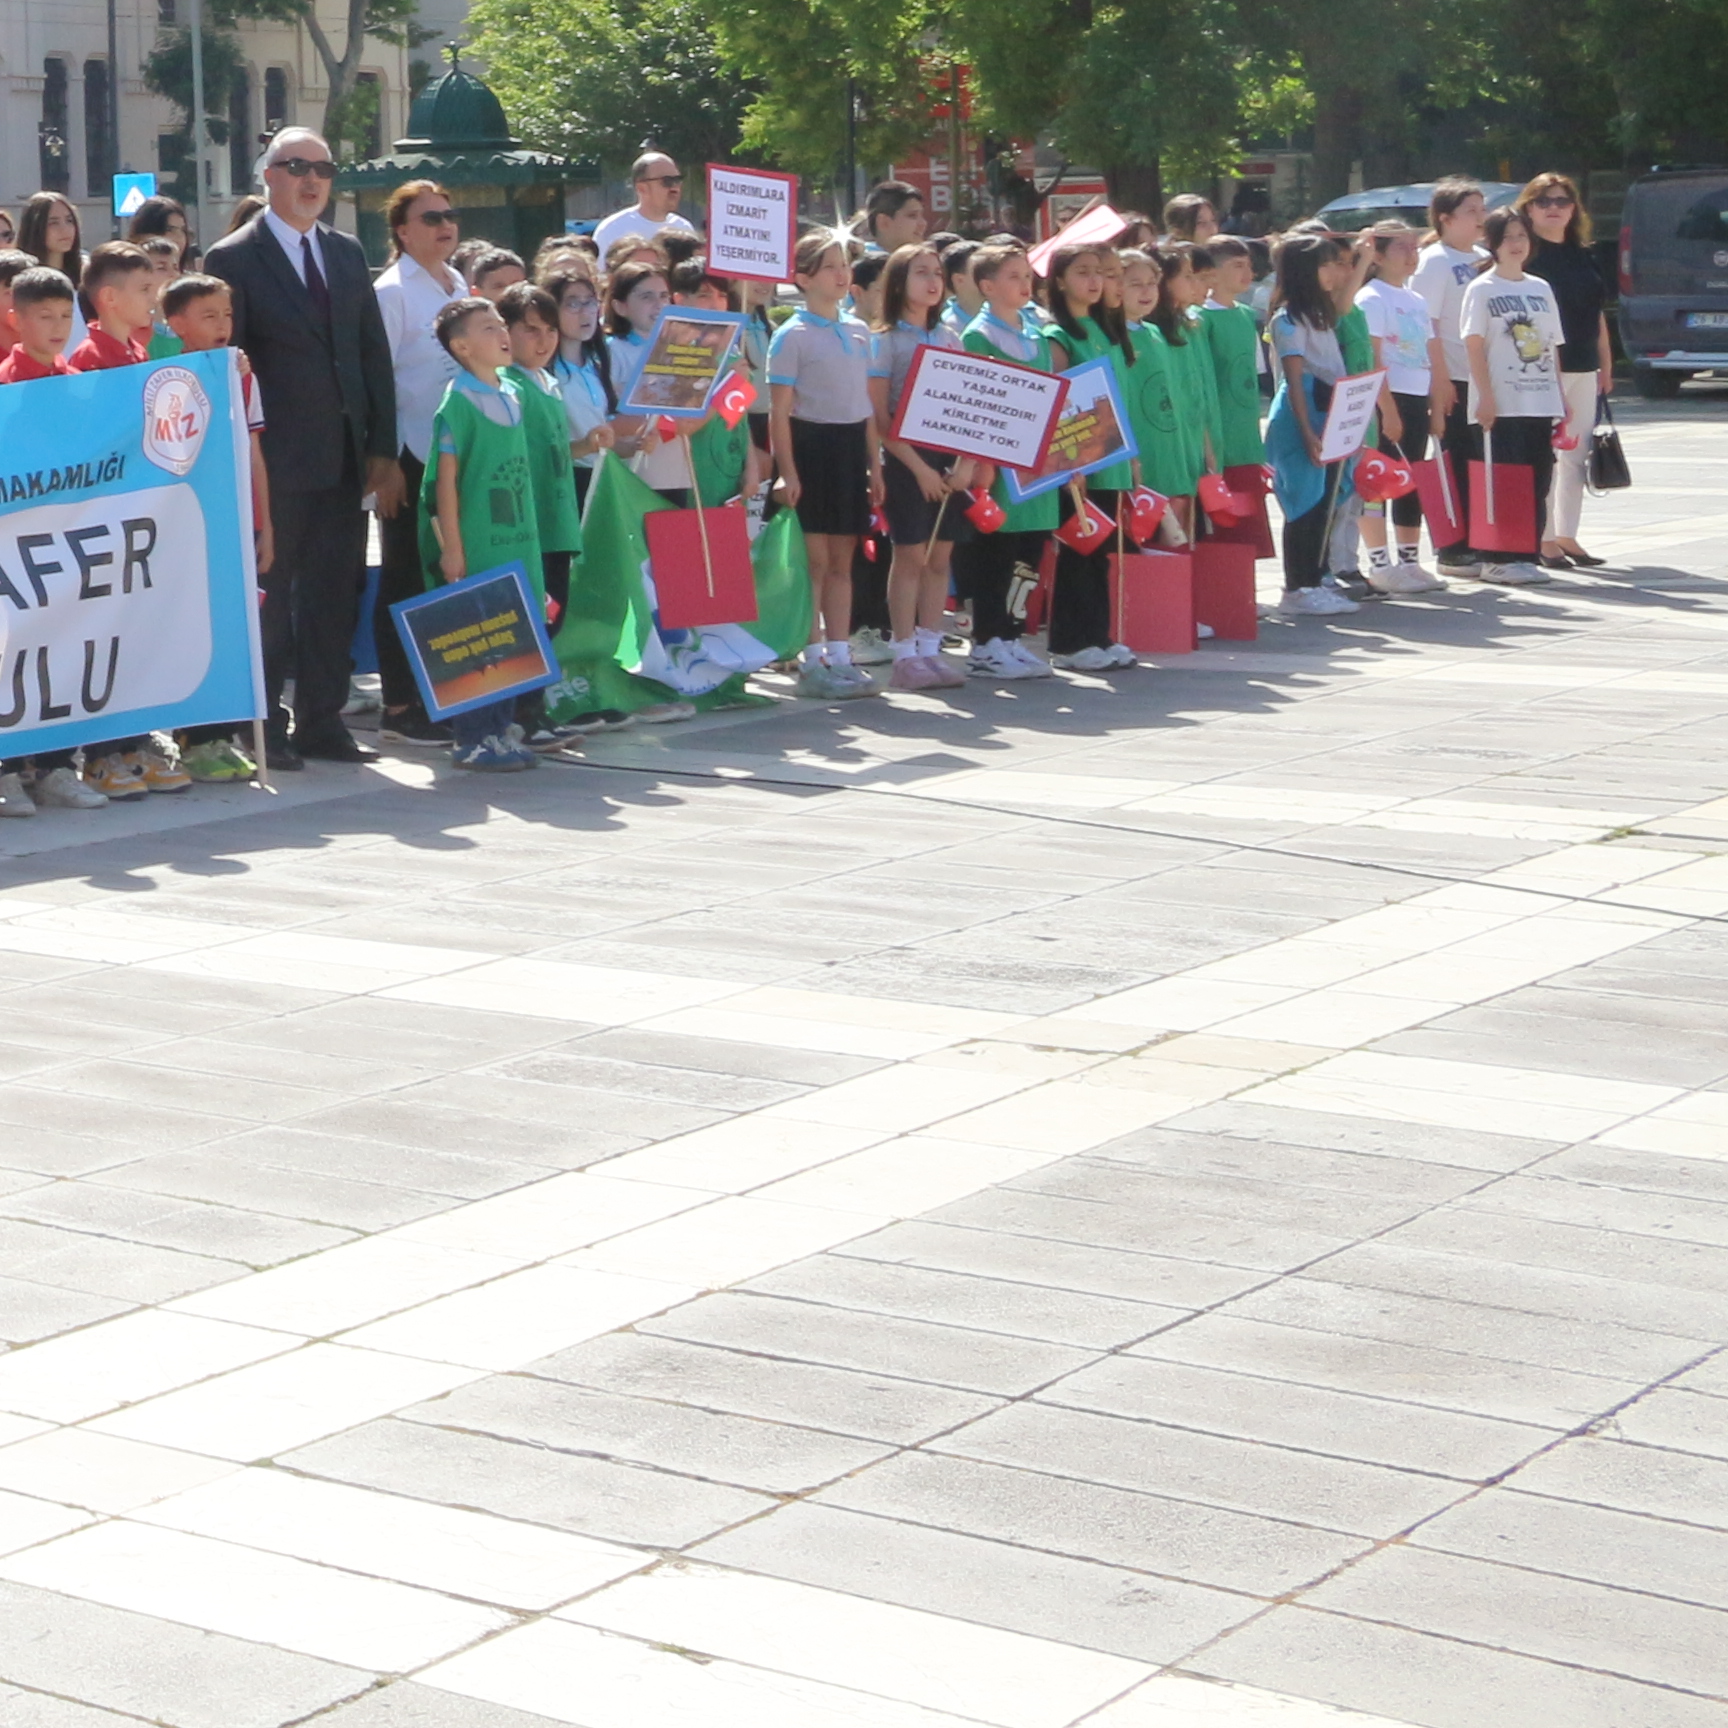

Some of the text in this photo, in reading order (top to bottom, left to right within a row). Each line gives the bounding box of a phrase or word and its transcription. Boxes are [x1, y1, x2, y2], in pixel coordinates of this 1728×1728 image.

[713, 180, 786, 202] KALDIRIMLARA
[726, 201, 769, 221] İZMARİT
[932, 358, 1047, 394] ÇEVREMİZ ORTAK
[962, 380, 1008, 398] YAŞAM
[923, 387, 1037, 423] ALANLARIMIZDIR!
[942, 406, 1008, 431] KİRLETME
[921, 418, 985, 441] HAKKINIZ
[988, 434, 1021, 450] YOK!
